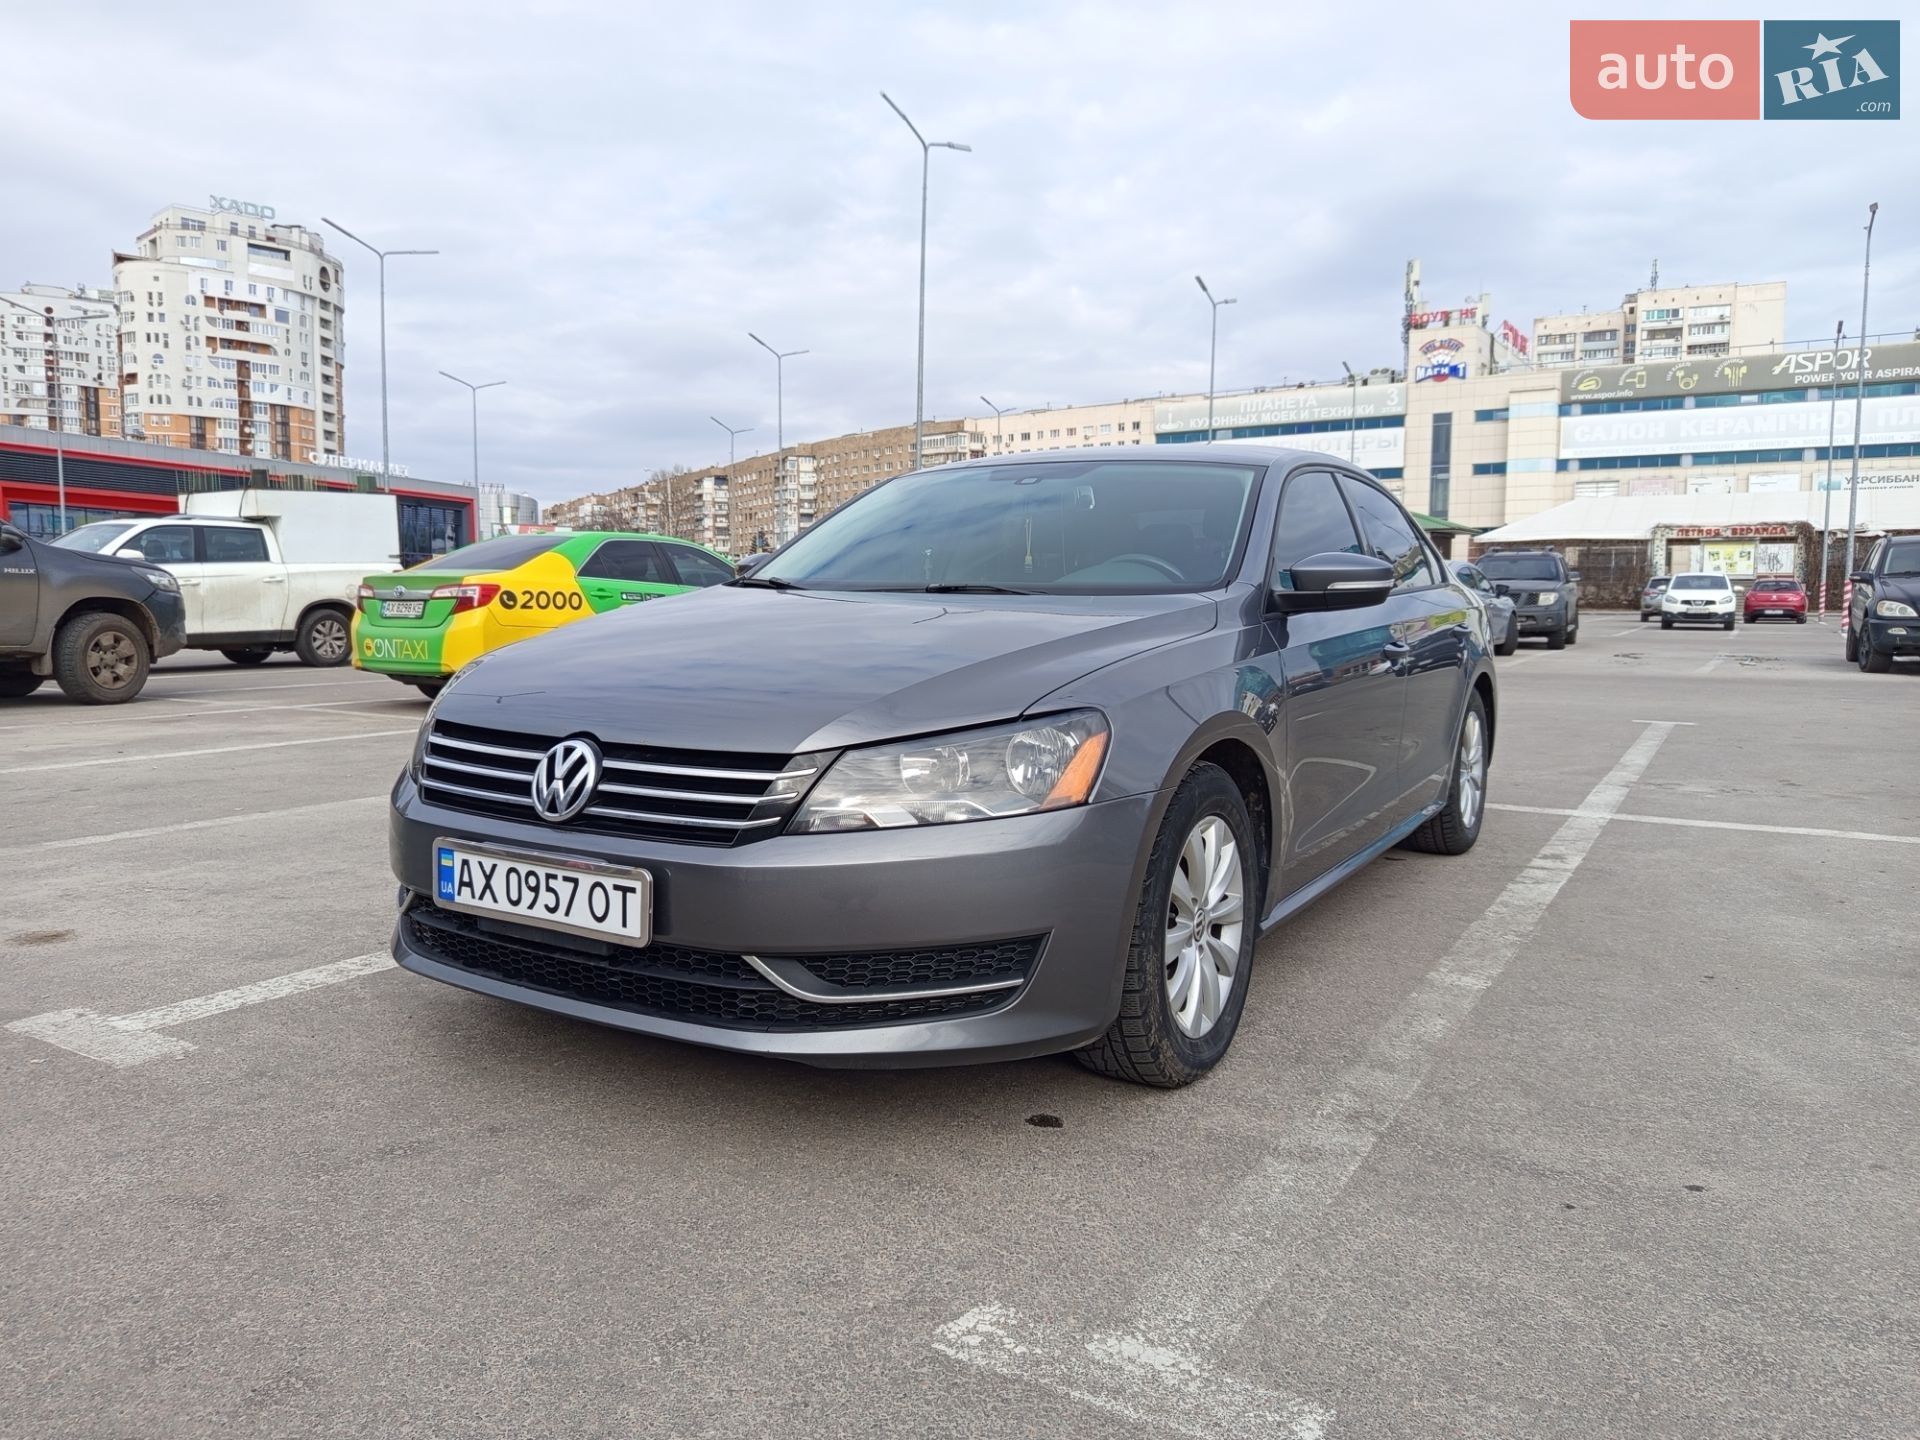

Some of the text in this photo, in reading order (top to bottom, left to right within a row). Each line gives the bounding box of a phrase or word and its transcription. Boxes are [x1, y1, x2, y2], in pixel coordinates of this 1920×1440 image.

[1772, 349, 1872, 375] ASPOR
[1240, 396, 1318, 413] ПЛАНЕТА
[1387, 387, 1398, 406] 3
[1571, 389, 1633, 401] www.aspor.info
[1189, 404, 1374, 428] КУХОННЫХ МОЕК И ТЕХНИКИ
[1574, 420, 1664, 442] САЛОН
[1731, 526, 1786, 536] ВЕРАНДА
[520, 590, 583, 611] 2000
[441, 880, 454, 895] UA
[457, 858, 637, 929] AX 0957 OT
